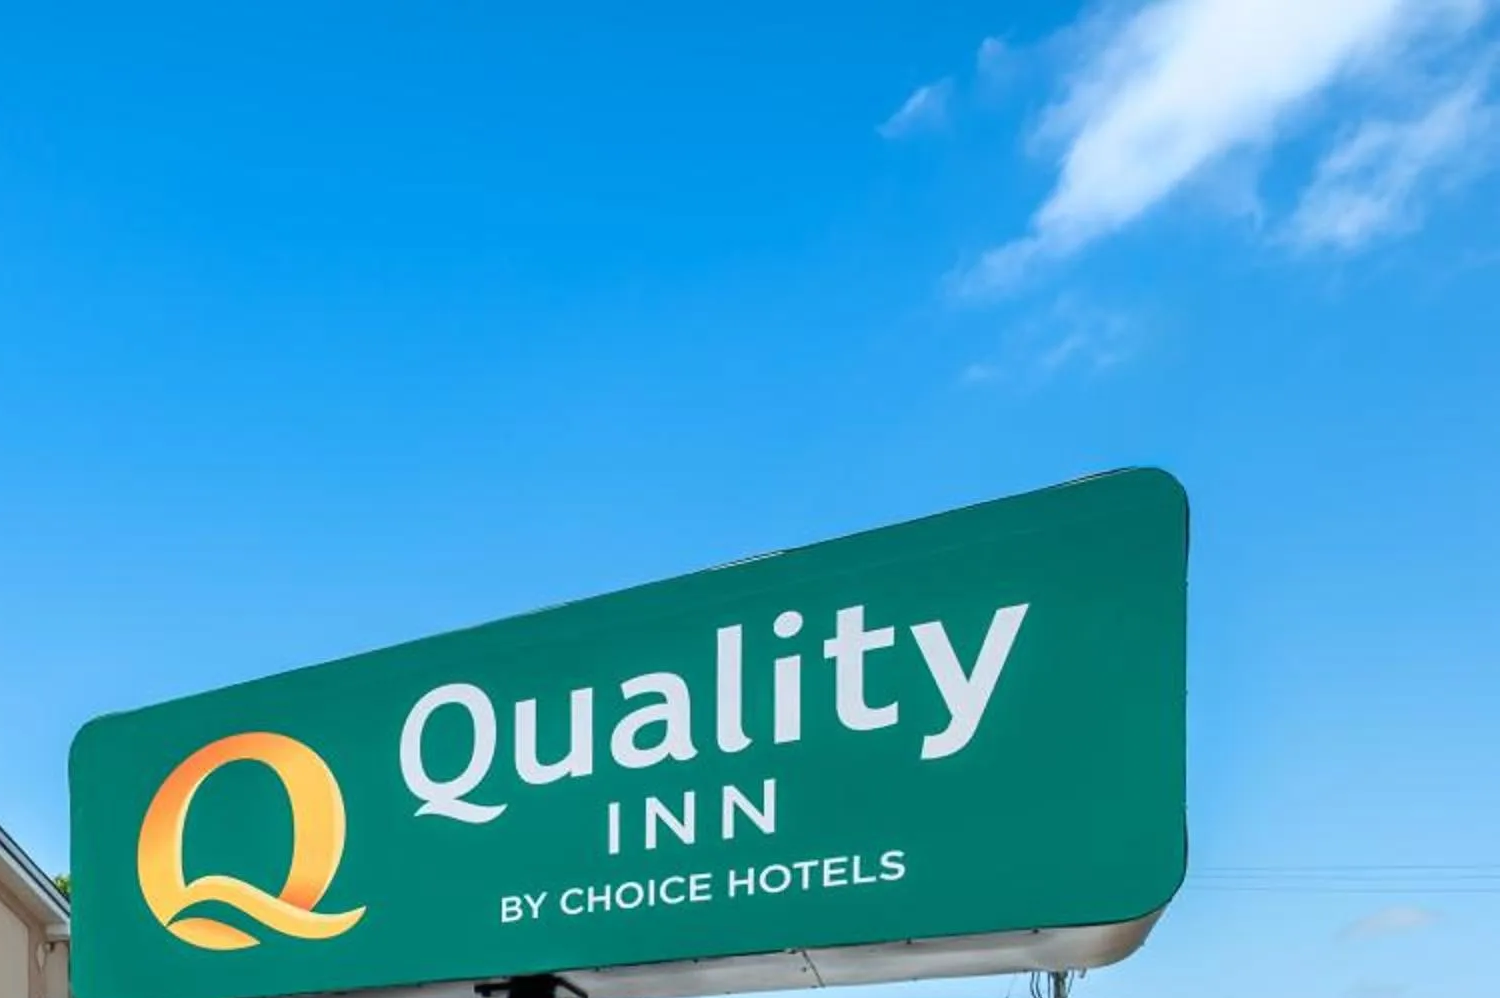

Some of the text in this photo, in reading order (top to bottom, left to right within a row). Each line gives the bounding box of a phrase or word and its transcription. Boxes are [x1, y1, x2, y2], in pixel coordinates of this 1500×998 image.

[399, 603, 1029, 824] Quality
[608, 779, 776, 854] INN
[501, 850, 906, 923] BY CHOICE HOTELS
